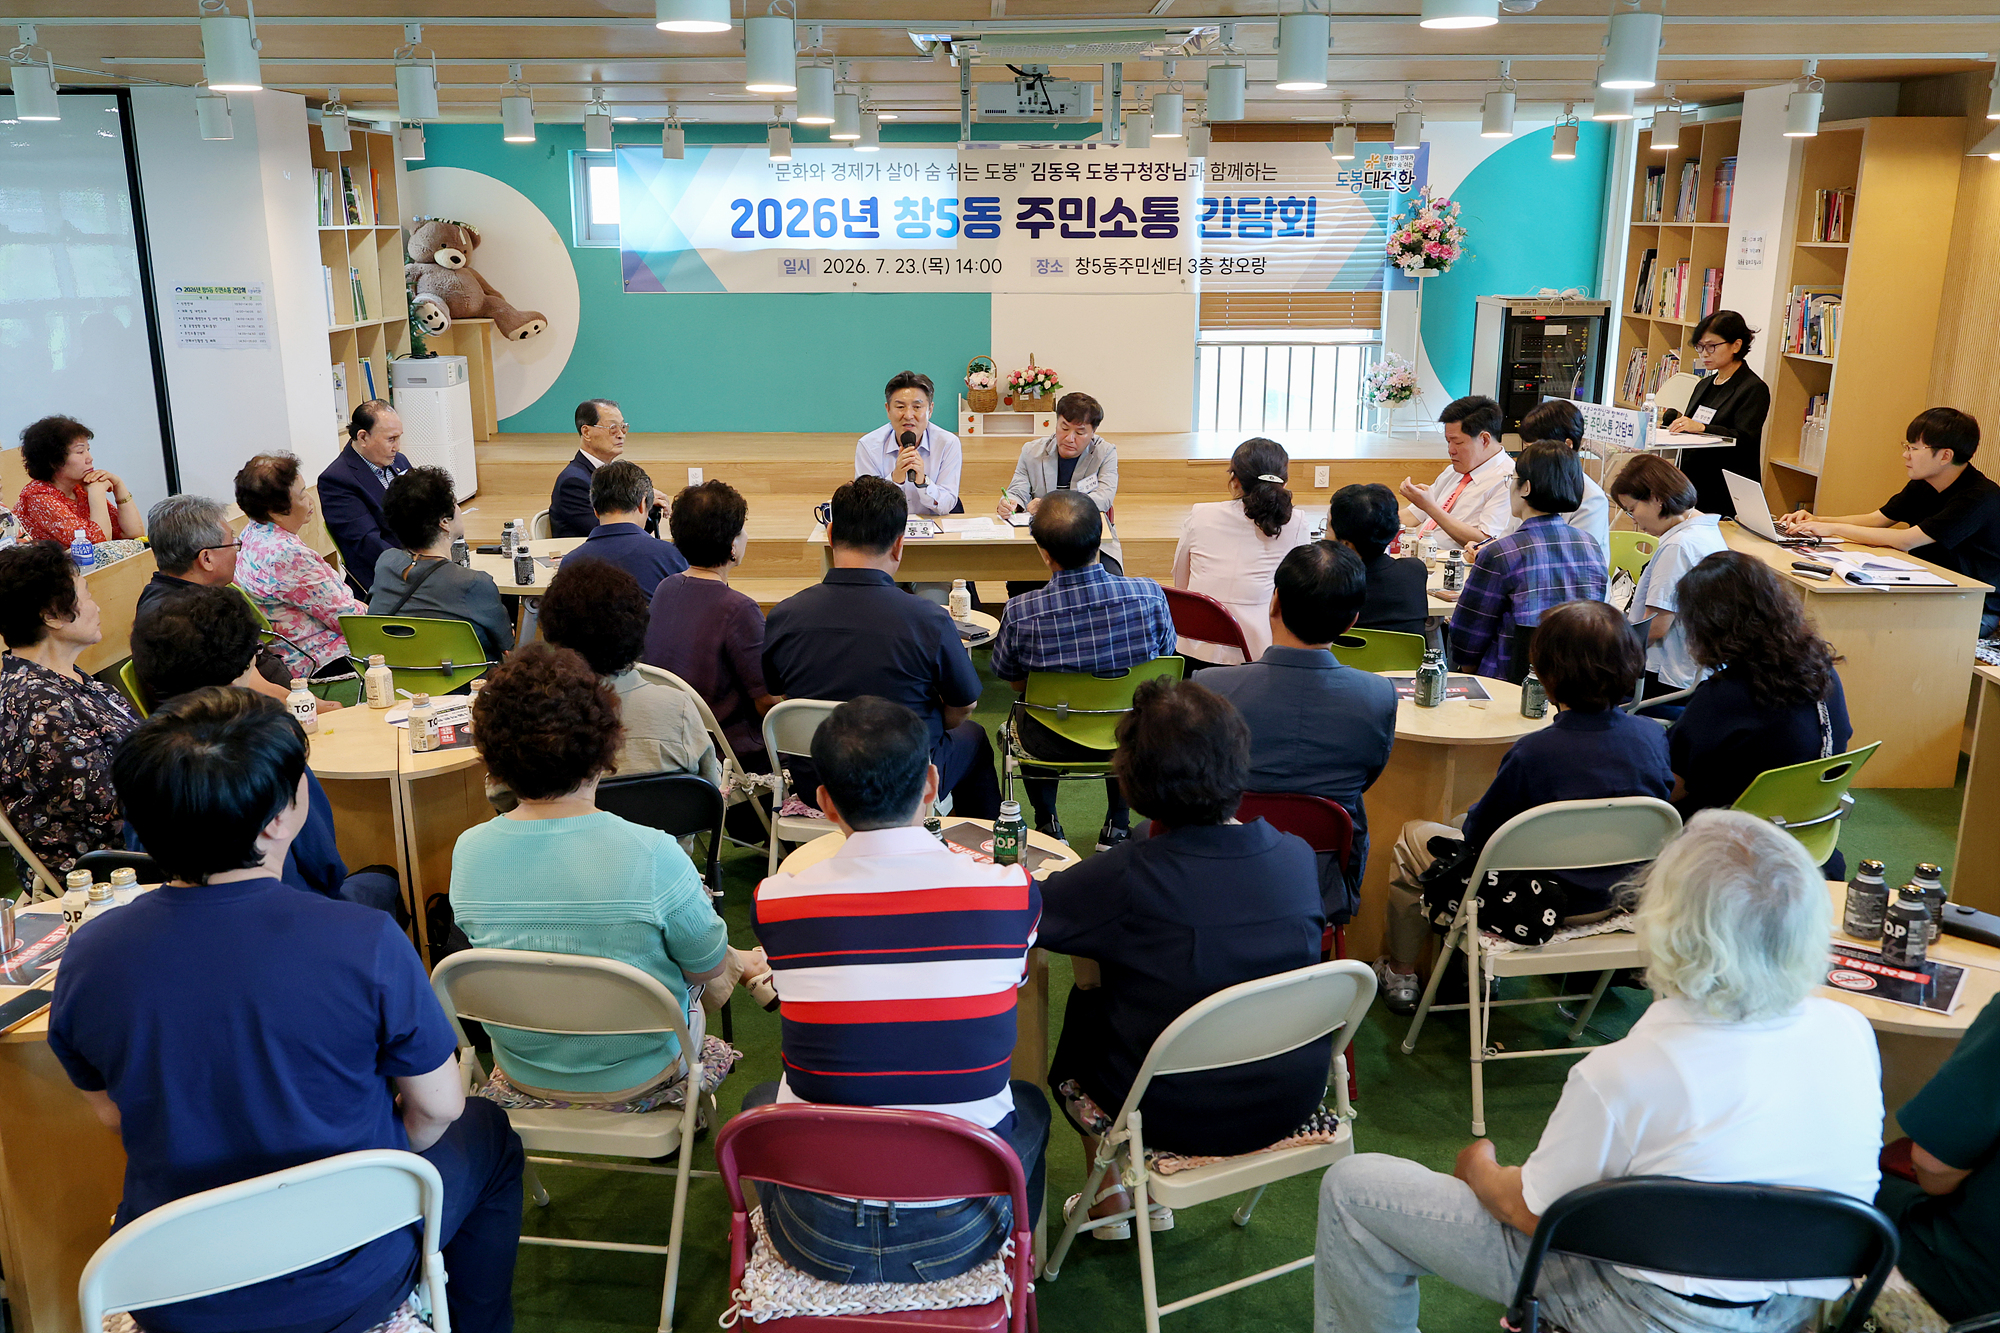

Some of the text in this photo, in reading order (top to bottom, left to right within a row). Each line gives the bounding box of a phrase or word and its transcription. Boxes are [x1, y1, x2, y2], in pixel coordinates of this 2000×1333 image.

[768, 162, 1278, 183] "문화와 경제가 살아 숨 쉬는 도봉" 김동욱 도봉구청장님과 함께하는
[1335, 169, 1416, 194] 도봉대전환
[730, 196, 1317, 239] 2026년 창5동 주민소통 간담회
[783, 258, 811, 275] 일시
[823, 257, 1002, 277] 2026. 7. 23.(목) 14:00
[1036, 258, 1064, 275] 장소
[1075, 257, 1267, 276] 창5동주민센터 3층 창오랑
[1590, 416, 1613, 436] 주민소통
[1615, 420, 1634, 439] 간담회
[294, 702, 315, 714] T.O.P
[1488, 871, 1499, 886] 5
[1502, 891, 1517, 903] 3
[1542, 908, 1557, 926] 8
[1514, 924, 1529, 937] 6
